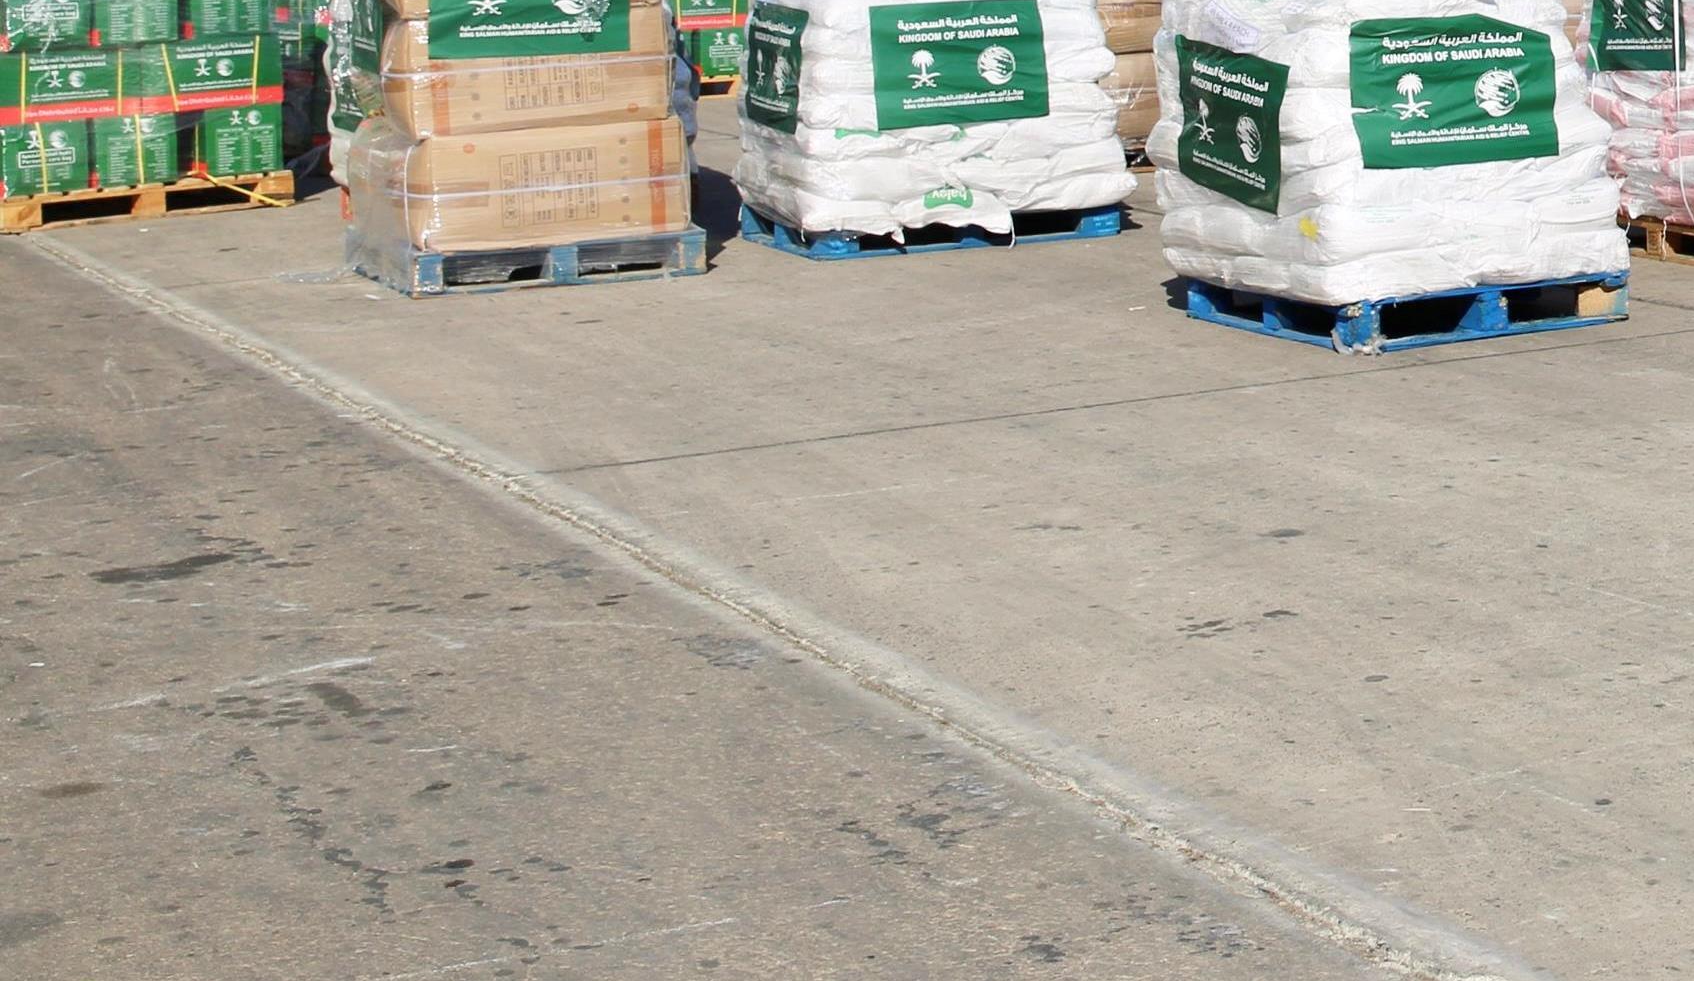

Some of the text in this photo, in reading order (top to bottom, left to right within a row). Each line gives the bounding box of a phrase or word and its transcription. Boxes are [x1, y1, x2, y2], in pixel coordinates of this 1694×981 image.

[899, 27, 1019, 43] KINGDOM OF SAUDI ARABIA
[1382, 48, 1524, 64] KINGDOM OF SAUDI ARABIA
